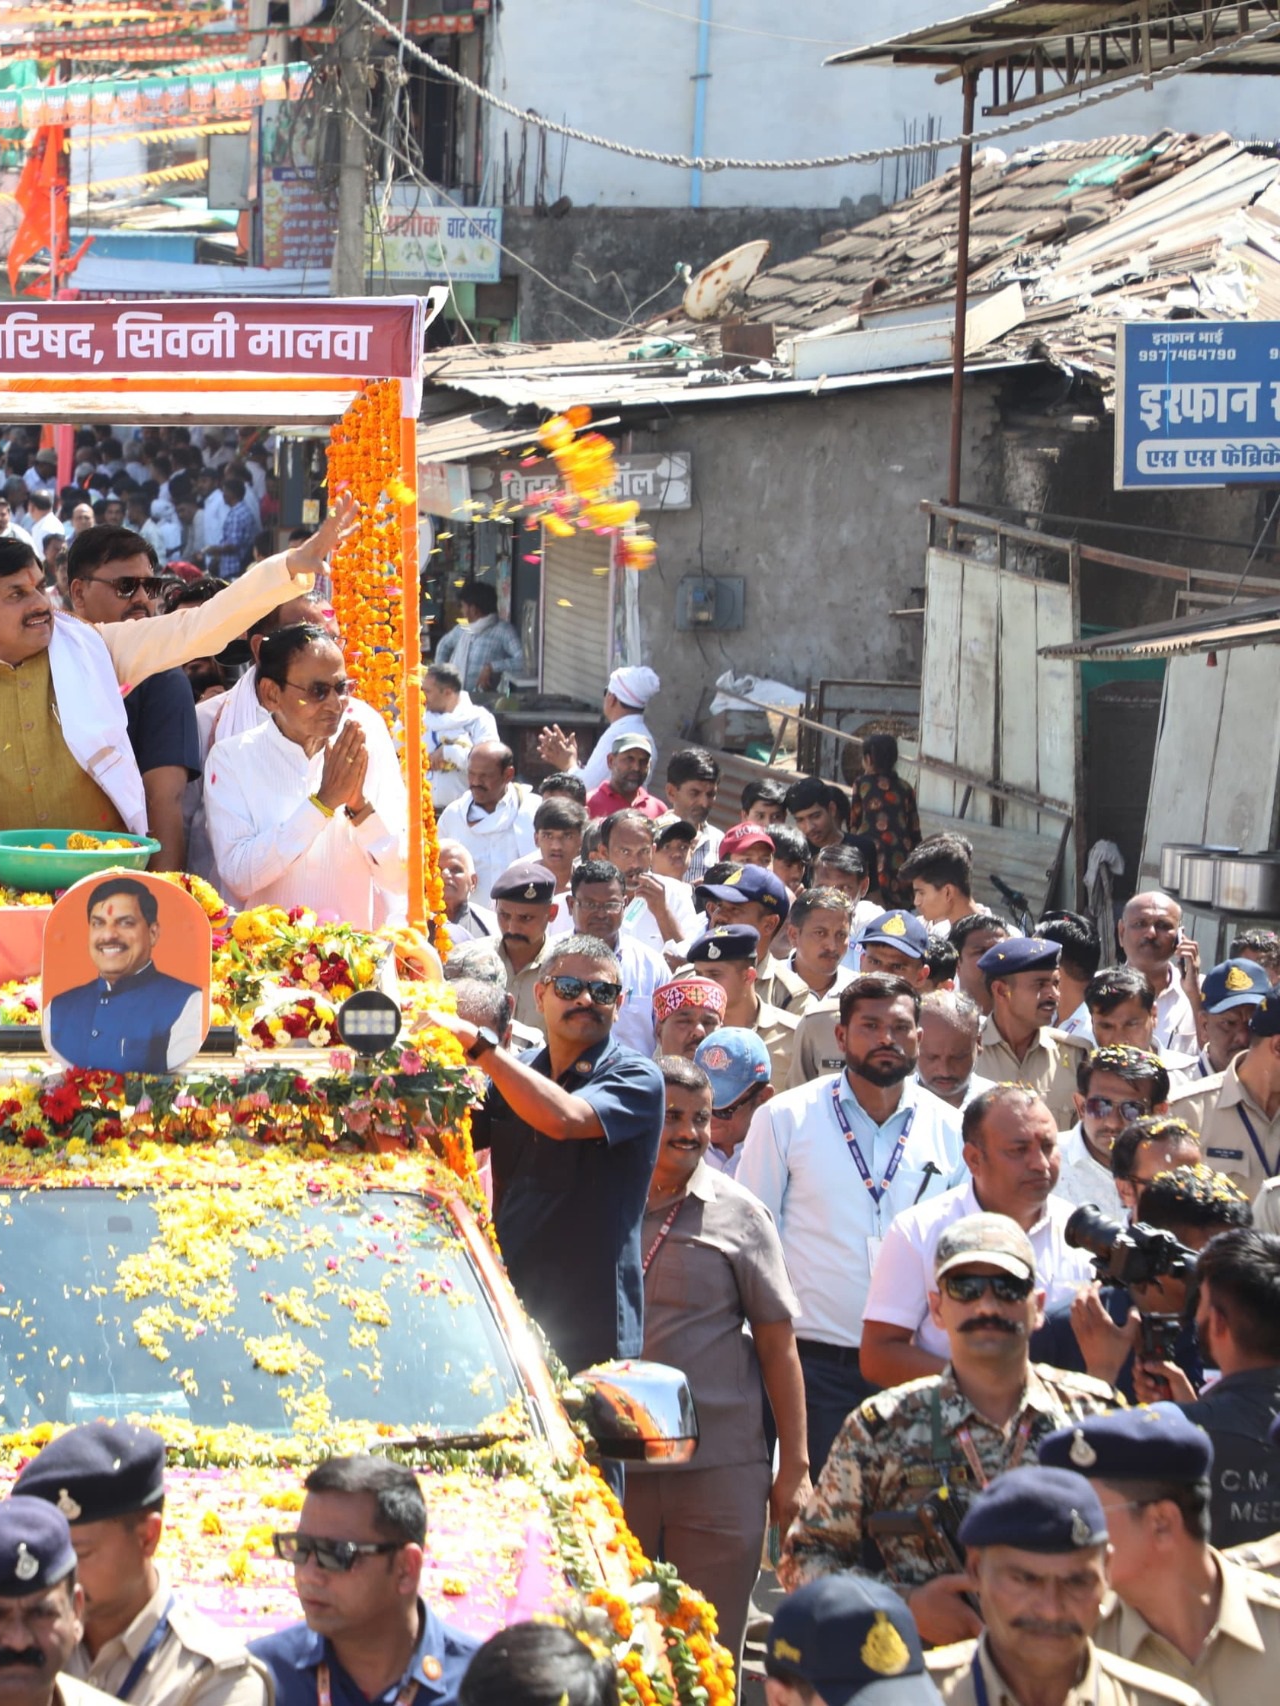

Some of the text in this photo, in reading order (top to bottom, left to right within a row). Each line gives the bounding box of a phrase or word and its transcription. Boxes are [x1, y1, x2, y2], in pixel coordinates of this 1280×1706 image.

[447, 217, 466, 239] चाट
[113, 312, 239, 361] सिवनी
[245, 325, 373, 361] मालवा
[1152, 329, 1224, 346] इरफान भाई
[1138, 348, 1237, 362] 9977464790
[1138, 382, 1261, 432] इरफान
[1146, 450, 1178, 467] एस
[1184, 450, 1216, 467] एस
